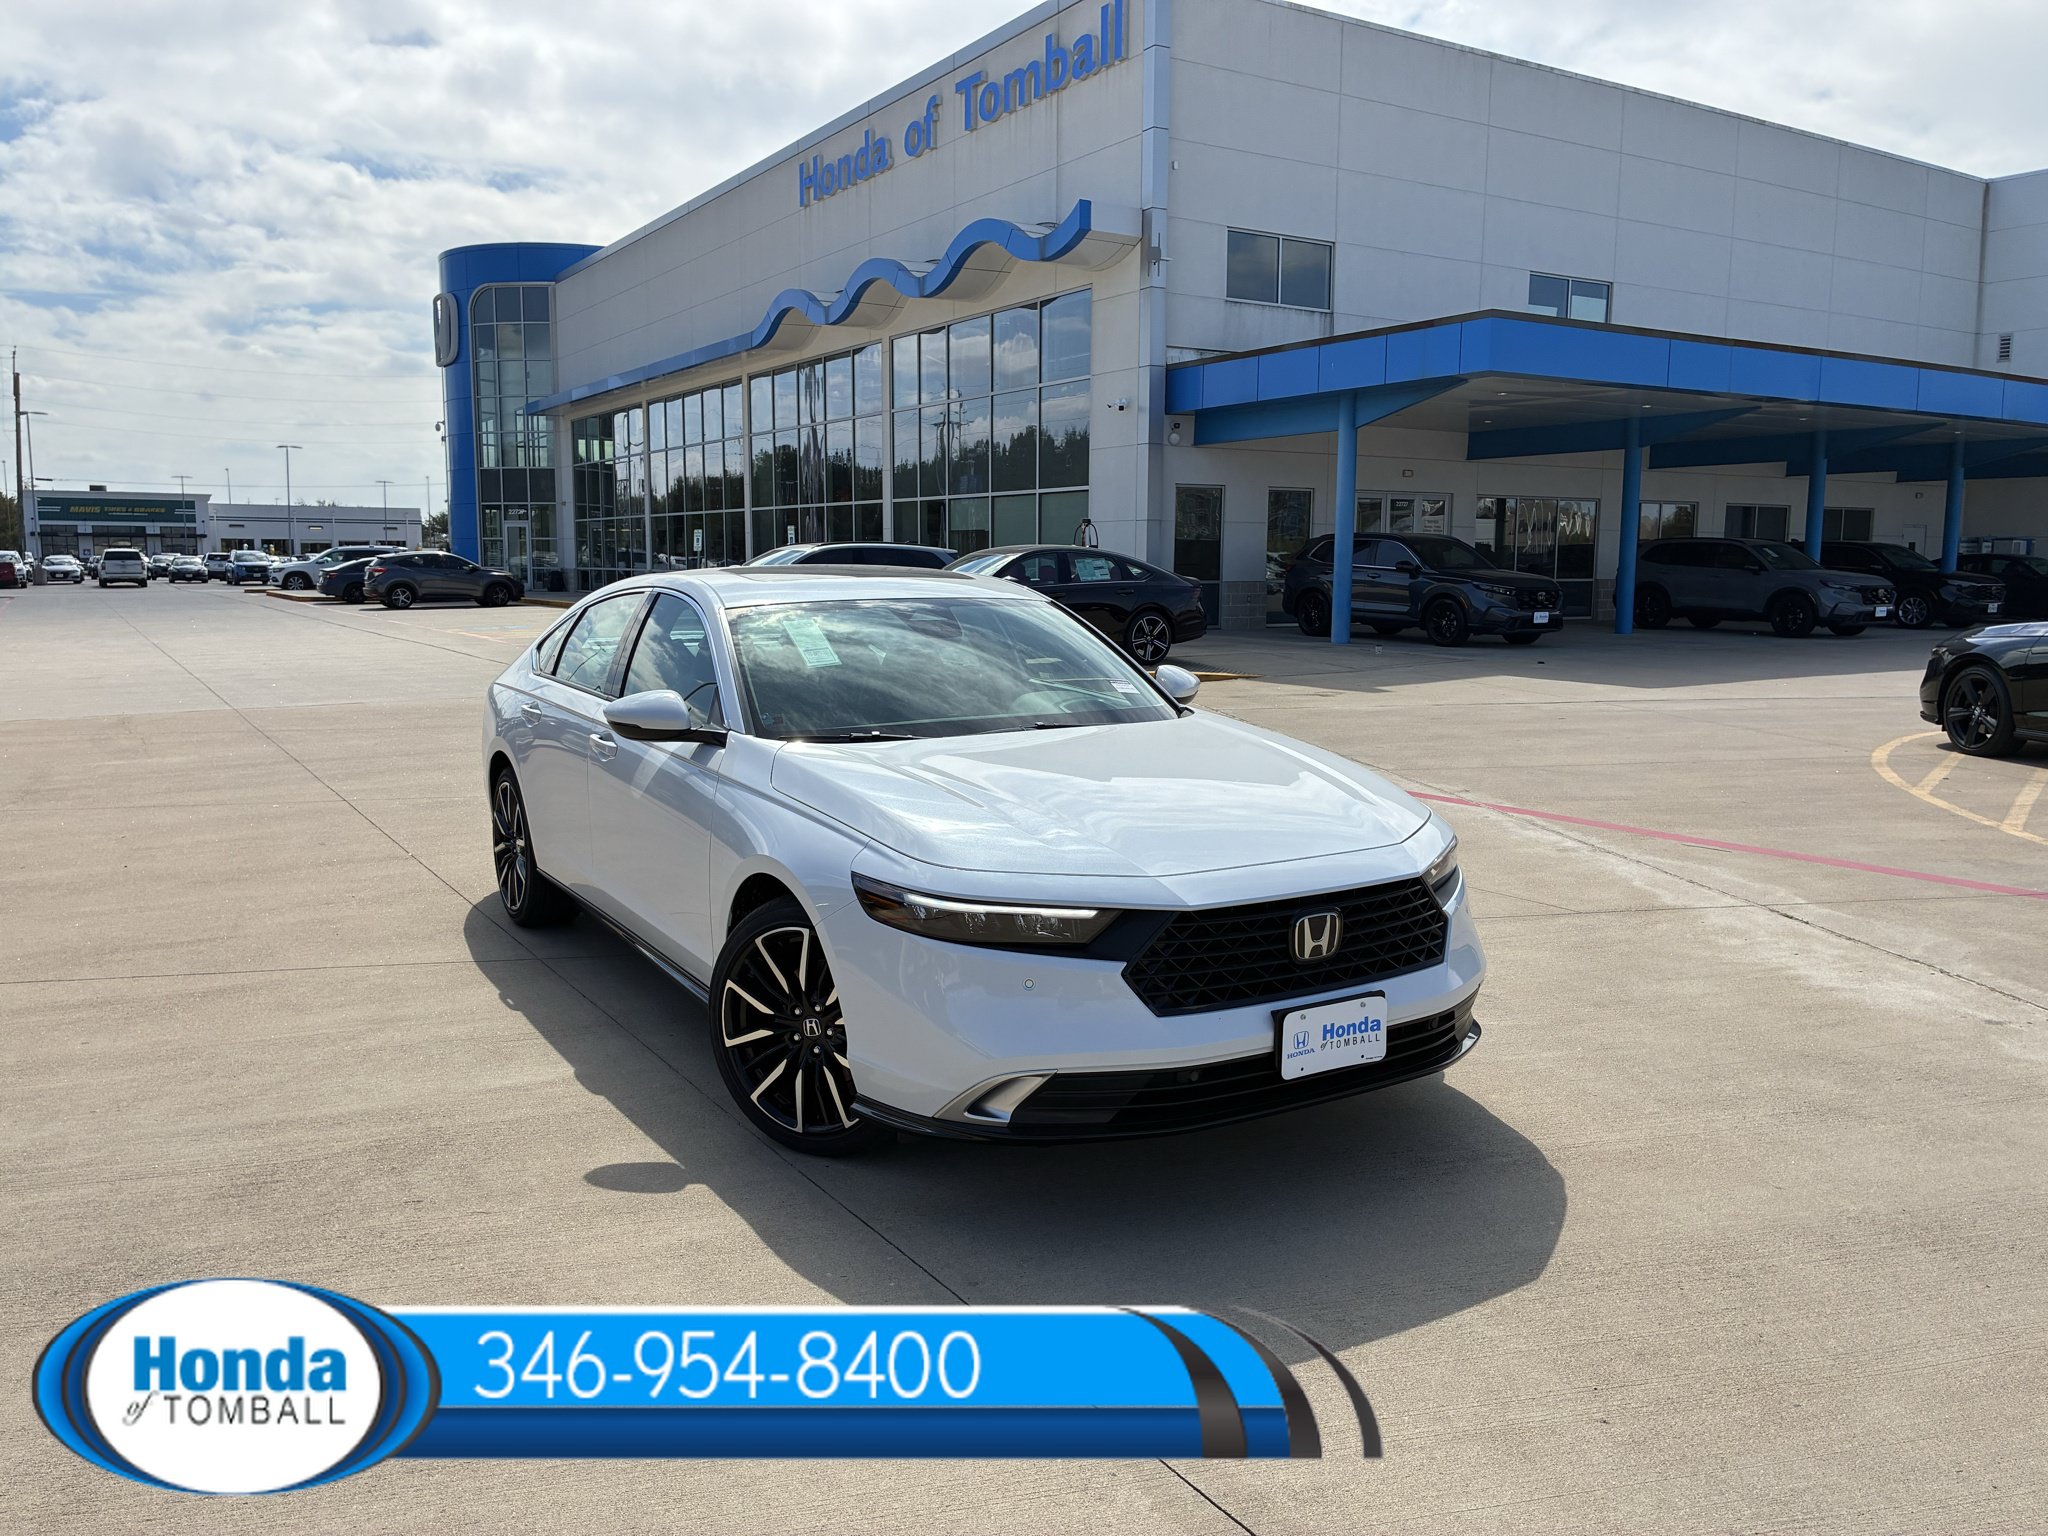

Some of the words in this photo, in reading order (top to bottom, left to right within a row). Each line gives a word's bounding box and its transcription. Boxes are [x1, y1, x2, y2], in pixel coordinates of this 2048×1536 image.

[799, 129, 893, 208] Honda
[904, 95, 941, 158] of
[955, 0, 1128, 132] Tomball
[69, 505, 101, 513] MAVIS
[1322, 1016, 1381, 1041] Honda
[1320, 1040, 1330, 1051] of
[1330, 1034, 1381, 1051] TOMBALL
[1286, 1048, 1316, 1060] HONDA
